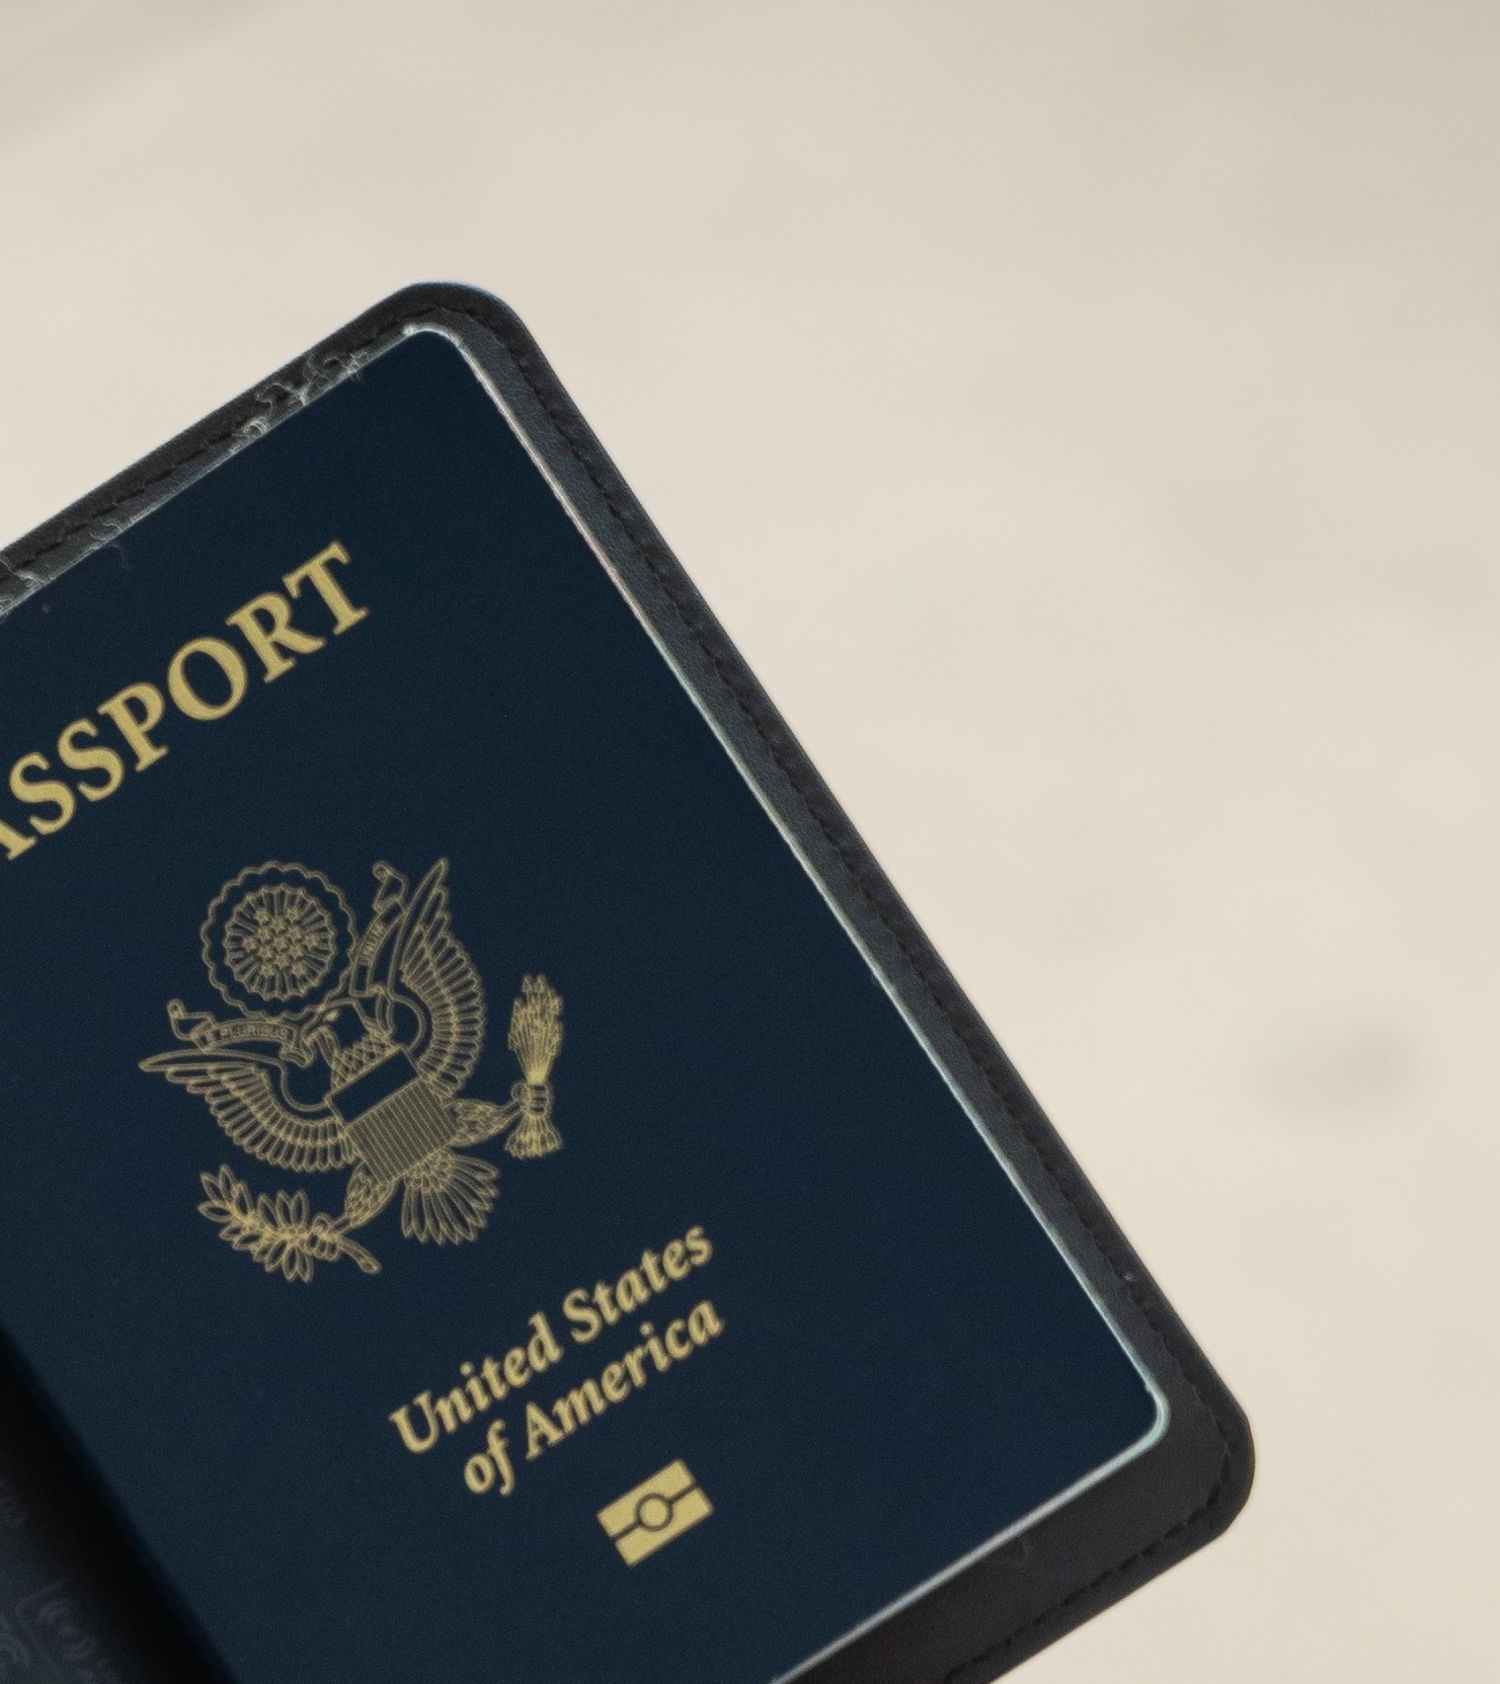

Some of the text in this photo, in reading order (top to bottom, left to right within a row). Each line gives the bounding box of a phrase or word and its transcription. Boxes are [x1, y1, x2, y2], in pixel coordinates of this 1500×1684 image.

[391, 1227, 712, 1453] United States
[465, 1301, 722, 1493] of America
